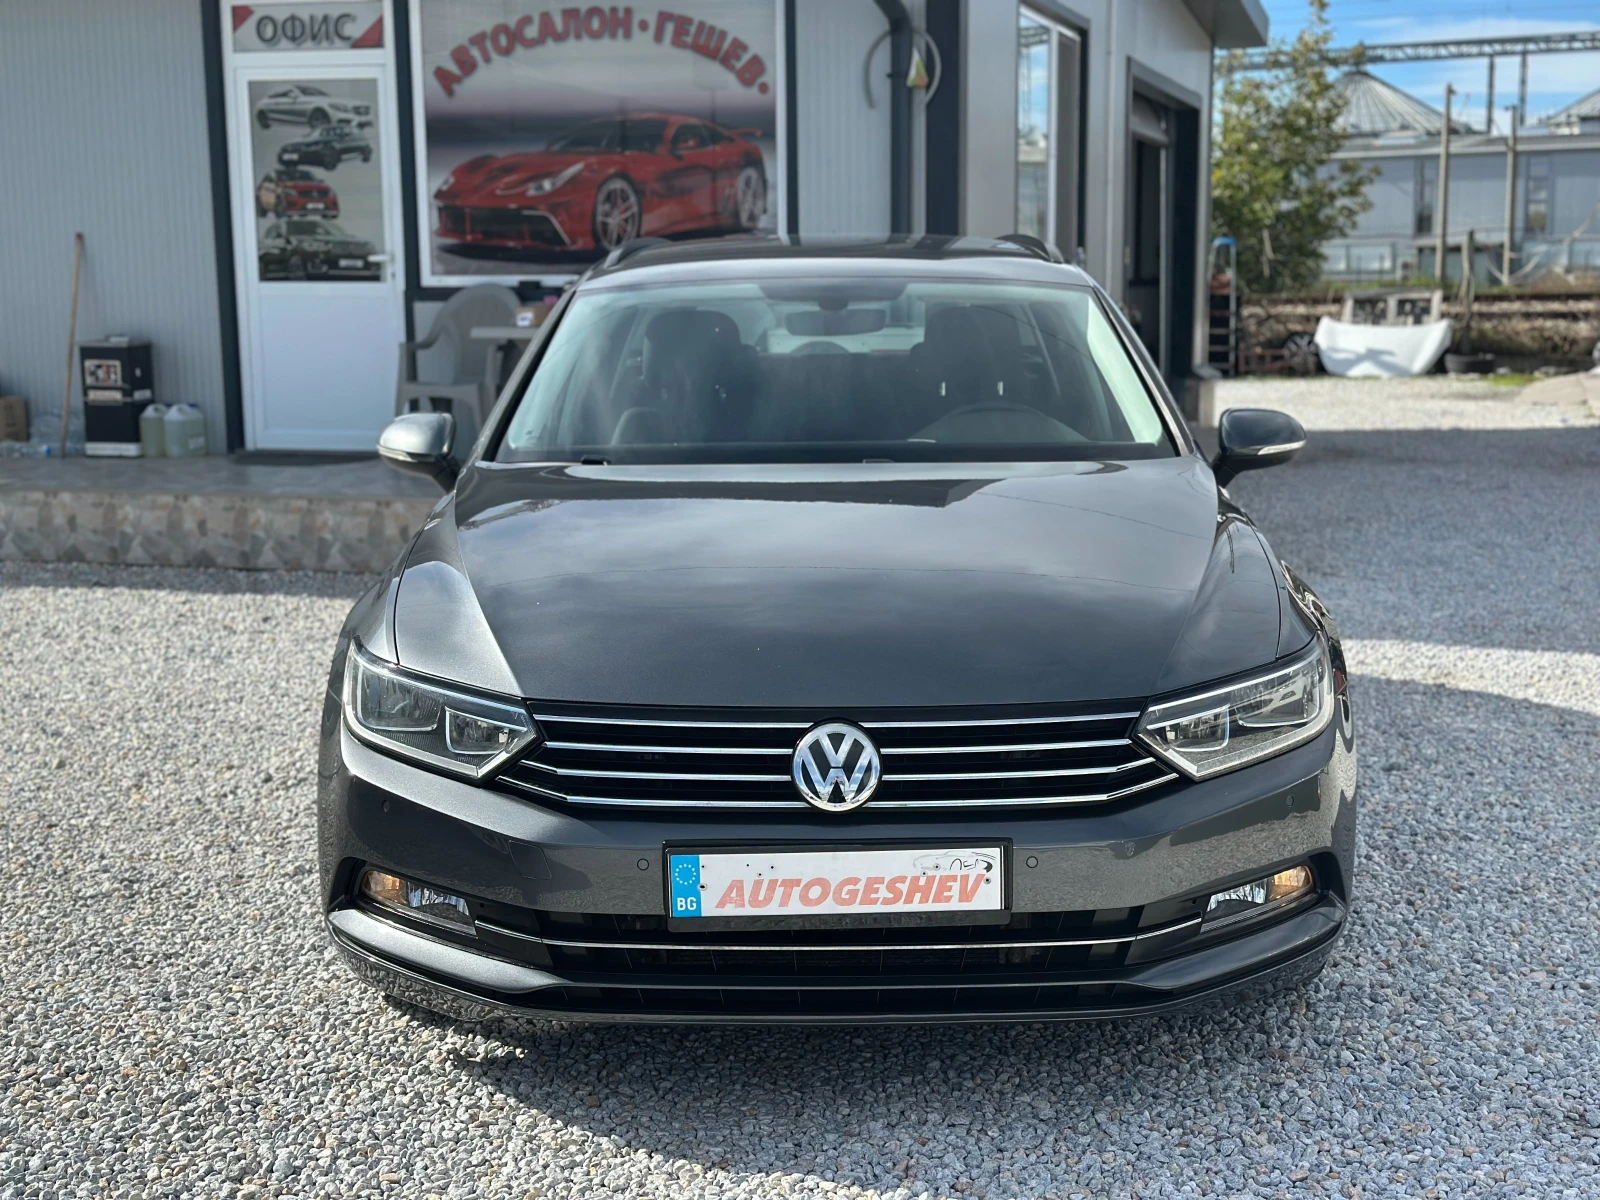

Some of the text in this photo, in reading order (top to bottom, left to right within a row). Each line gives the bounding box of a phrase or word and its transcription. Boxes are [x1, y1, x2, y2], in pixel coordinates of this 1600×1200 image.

[256, 14, 356, 46] ОФИС
[434, 7, 766, 97] АВТОСАЛОН ГЕШЕВ
[677, 897, 697, 911] BG
[715, 874, 985, 909] AUTOGESHEV
